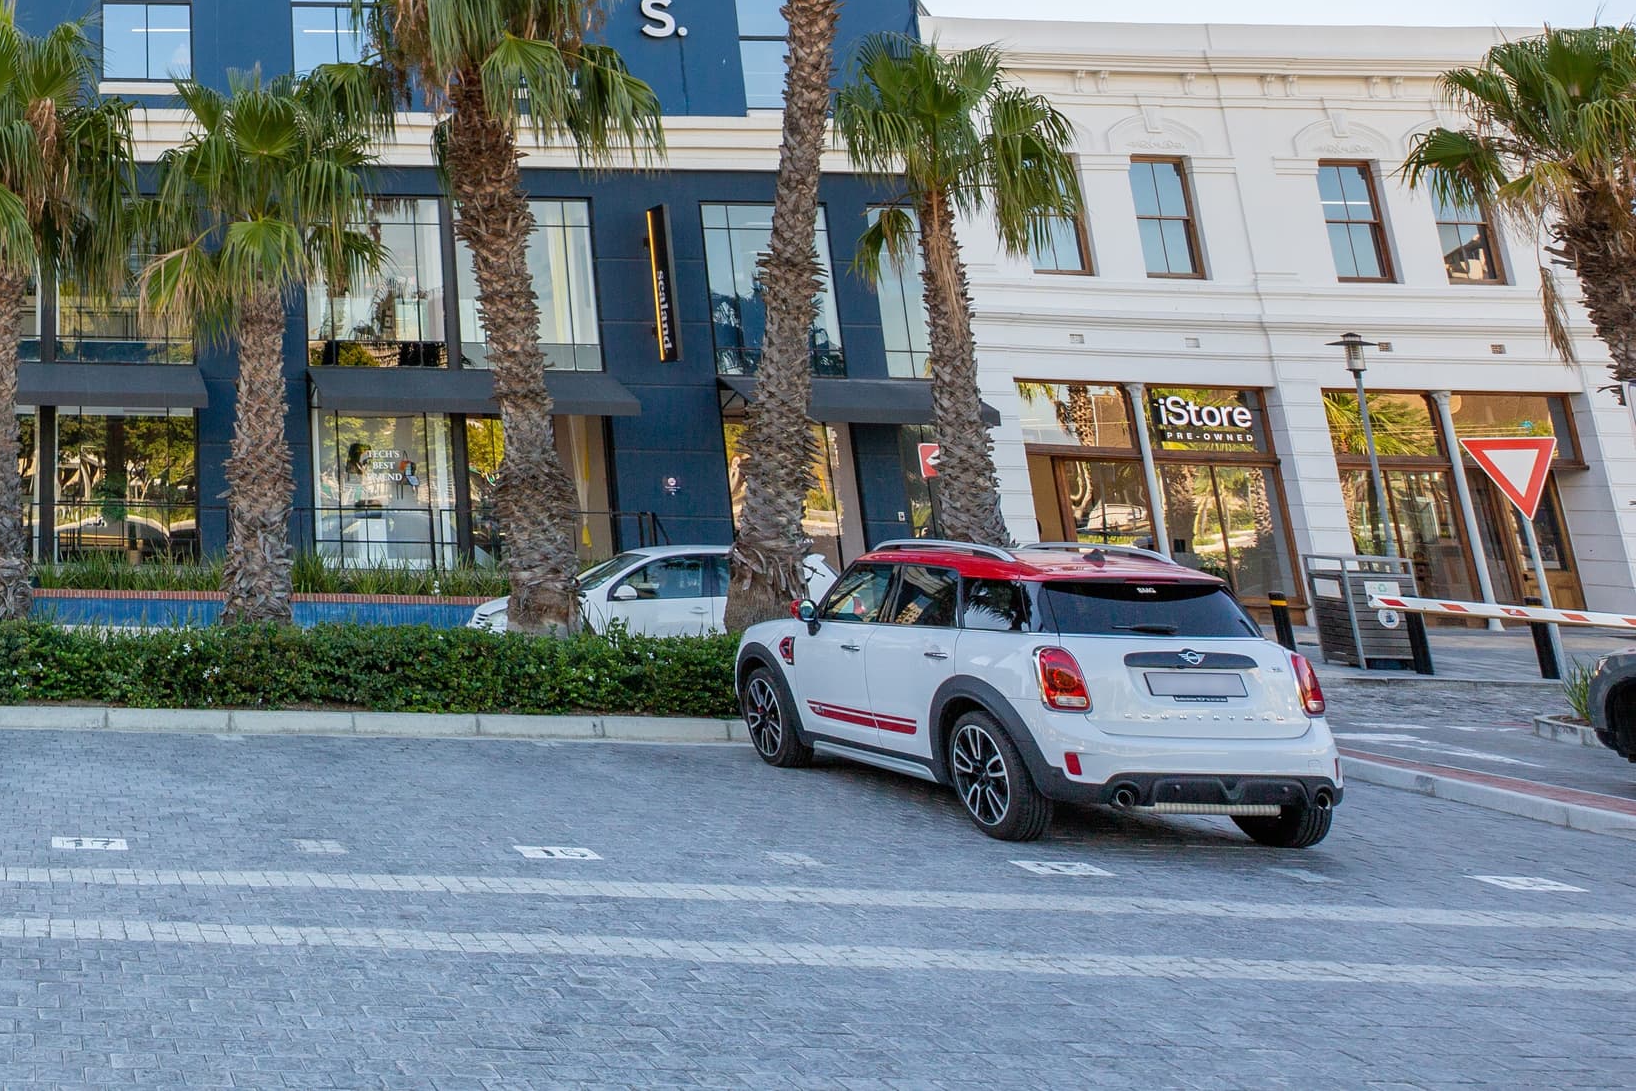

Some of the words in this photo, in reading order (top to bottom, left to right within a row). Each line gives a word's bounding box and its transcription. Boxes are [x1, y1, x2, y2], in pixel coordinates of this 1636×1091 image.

[1158, 396, 1252, 428] iStore
[1166, 431, 1254, 442] PRE-OWNED
[372, 461, 395, 470] BEST
